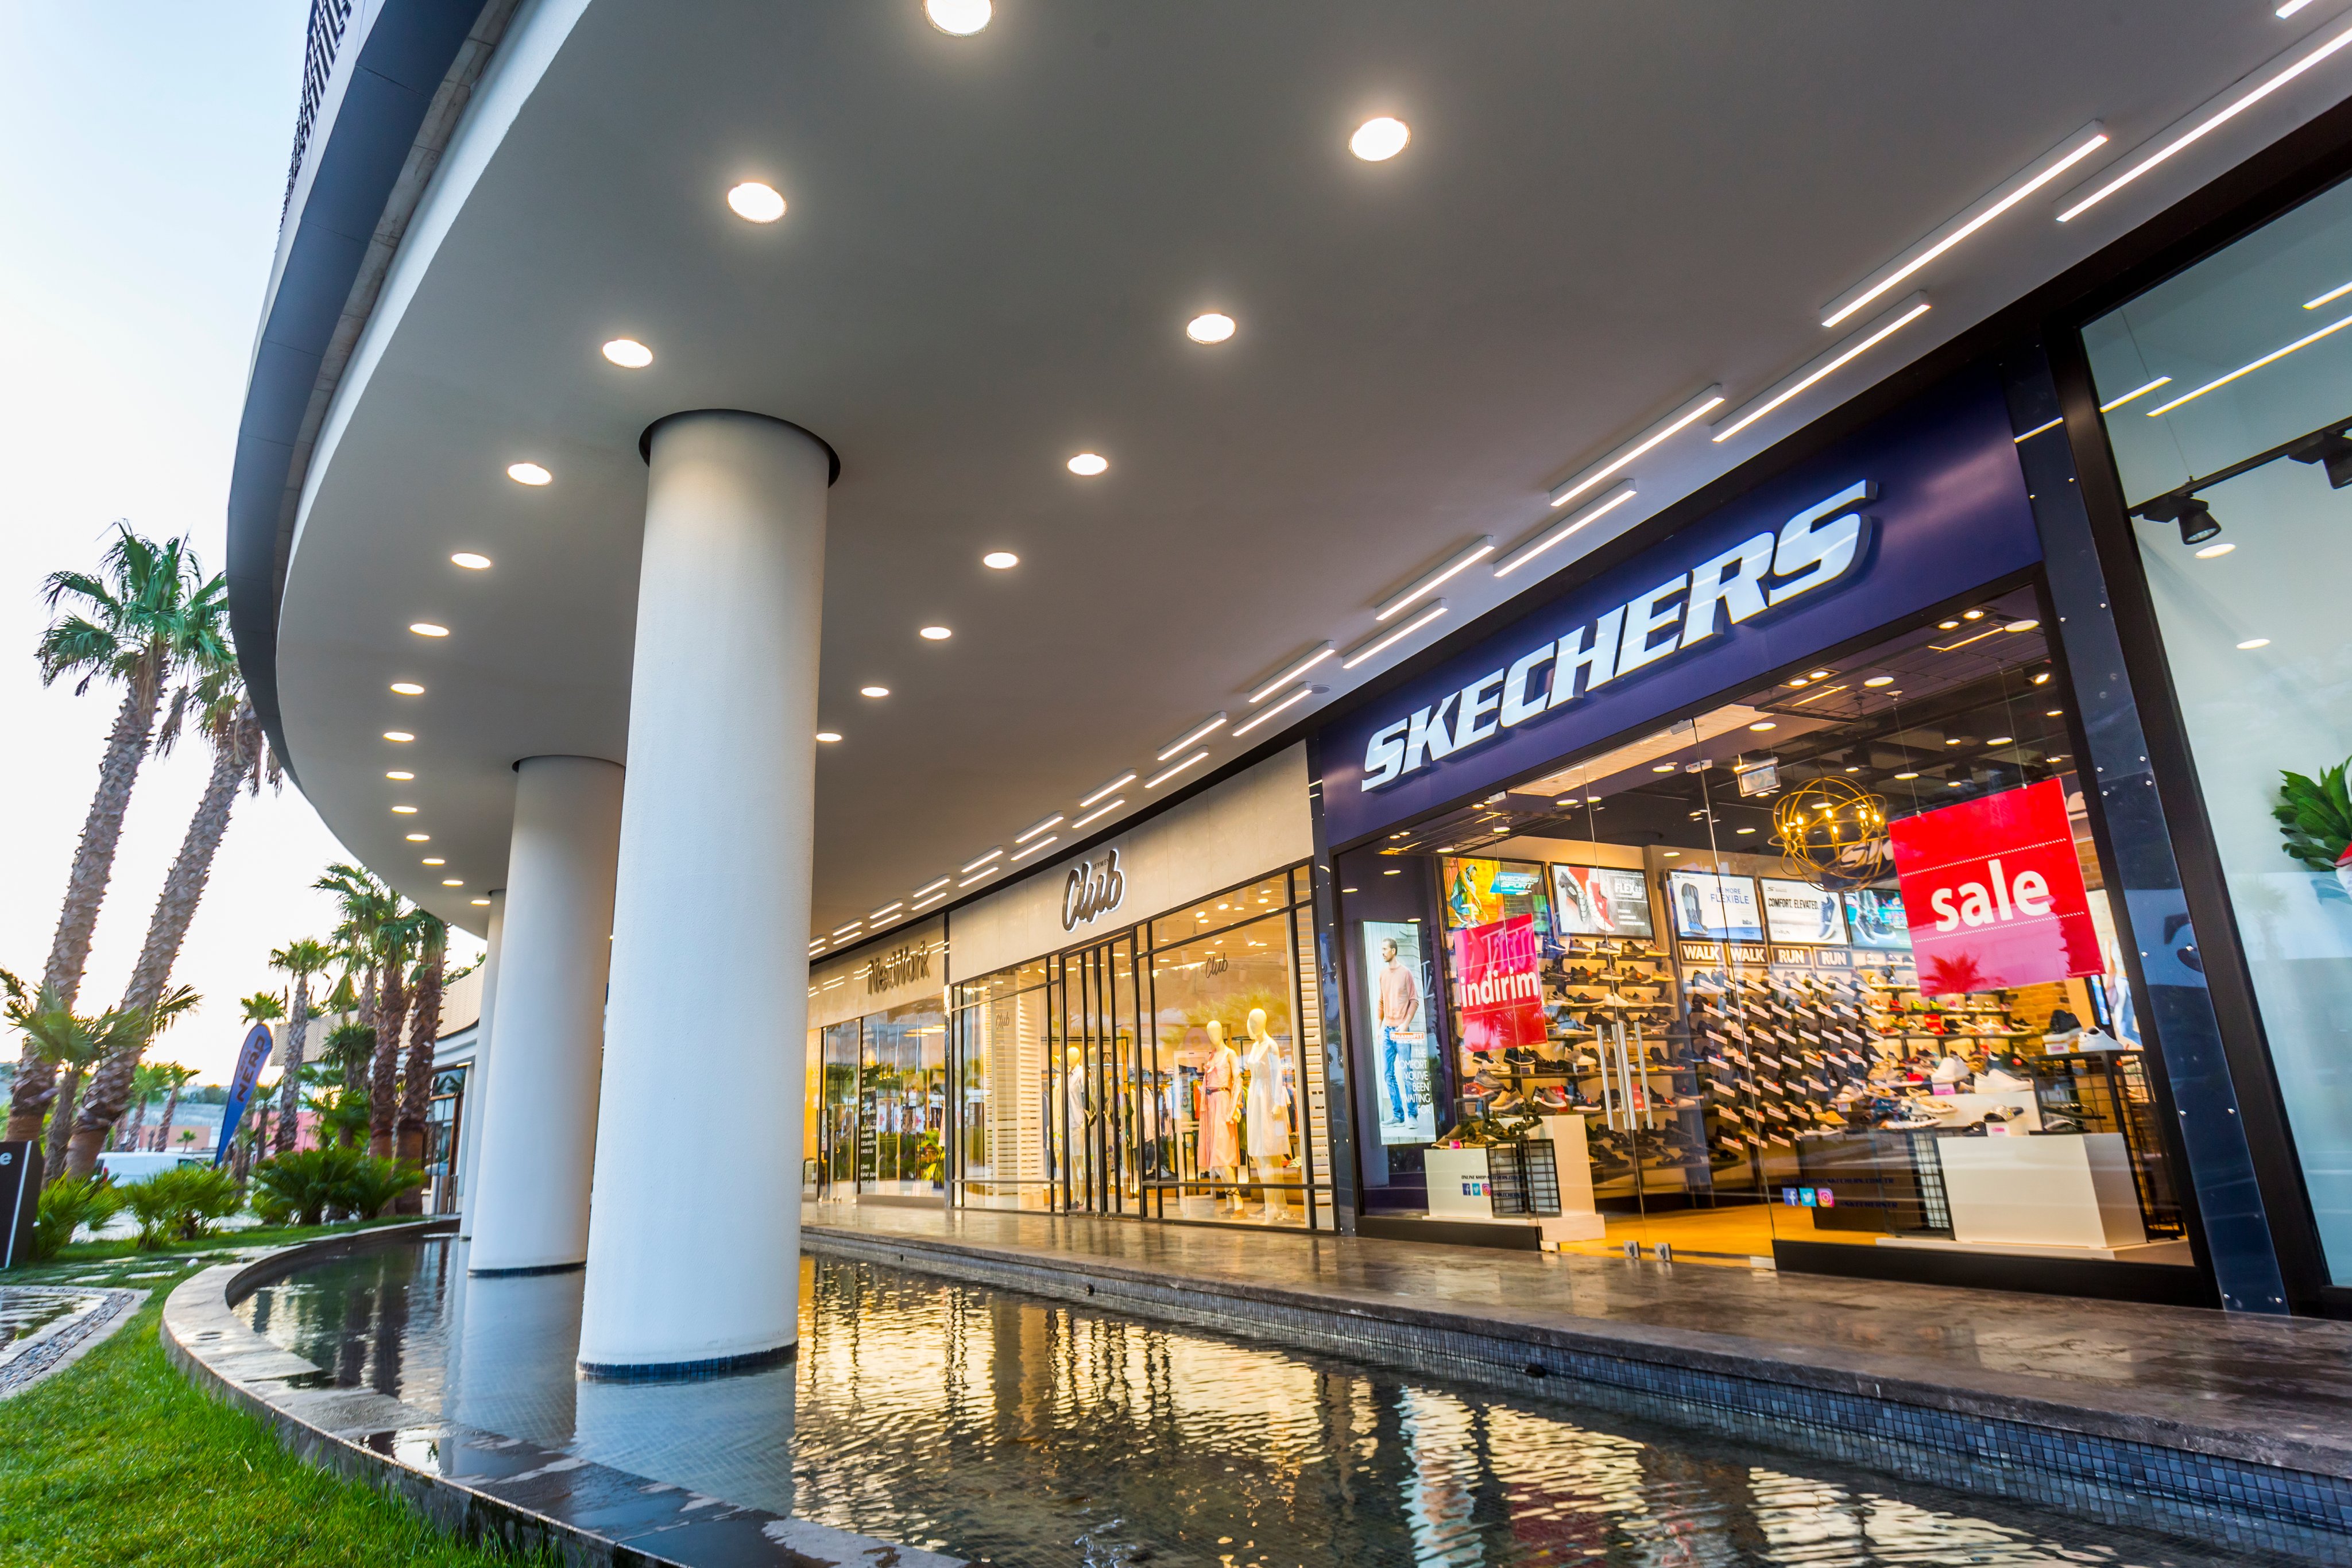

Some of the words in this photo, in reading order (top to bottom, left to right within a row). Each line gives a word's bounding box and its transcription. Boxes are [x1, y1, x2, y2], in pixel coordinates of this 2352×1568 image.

[1361, 479, 1878, 792] SKECHERS
[1062, 850, 1124, 931] Club
[1500, 881, 1534, 889] SPORT
[1615, 882, 1635, 893] FLEX
[1711, 893, 1750, 904] FLEXIBLE
[1931, 858, 2051, 932] sale
[1768, 898, 1793, 908] COMFORT.
[1794, 899, 1820, 909] ELEVATED.
[1683, 945, 1721, 961] WALK
[1731, 947, 1766, 962] WALK
[1780, 949, 1805, 964] RUN
[1821, 951, 1847, 965] RUN
[868, 940, 930, 996] NetWork
[1206, 952, 1228, 978] Club
[1460, 966, 1539, 1008] indirim
[996, 1011, 1009, 1030] Club
[1415, 1048, 1426, 1058] THE
[237, 1035, 265, 1102] NERD
[1395, 1060, 1428, 1069] OMFORT
[1412, 1082, 1430, 1092] BEEN
[1403, 1094, 1431, 1103] WAITING
[1417, 1104, 1432, 1114] FOR
